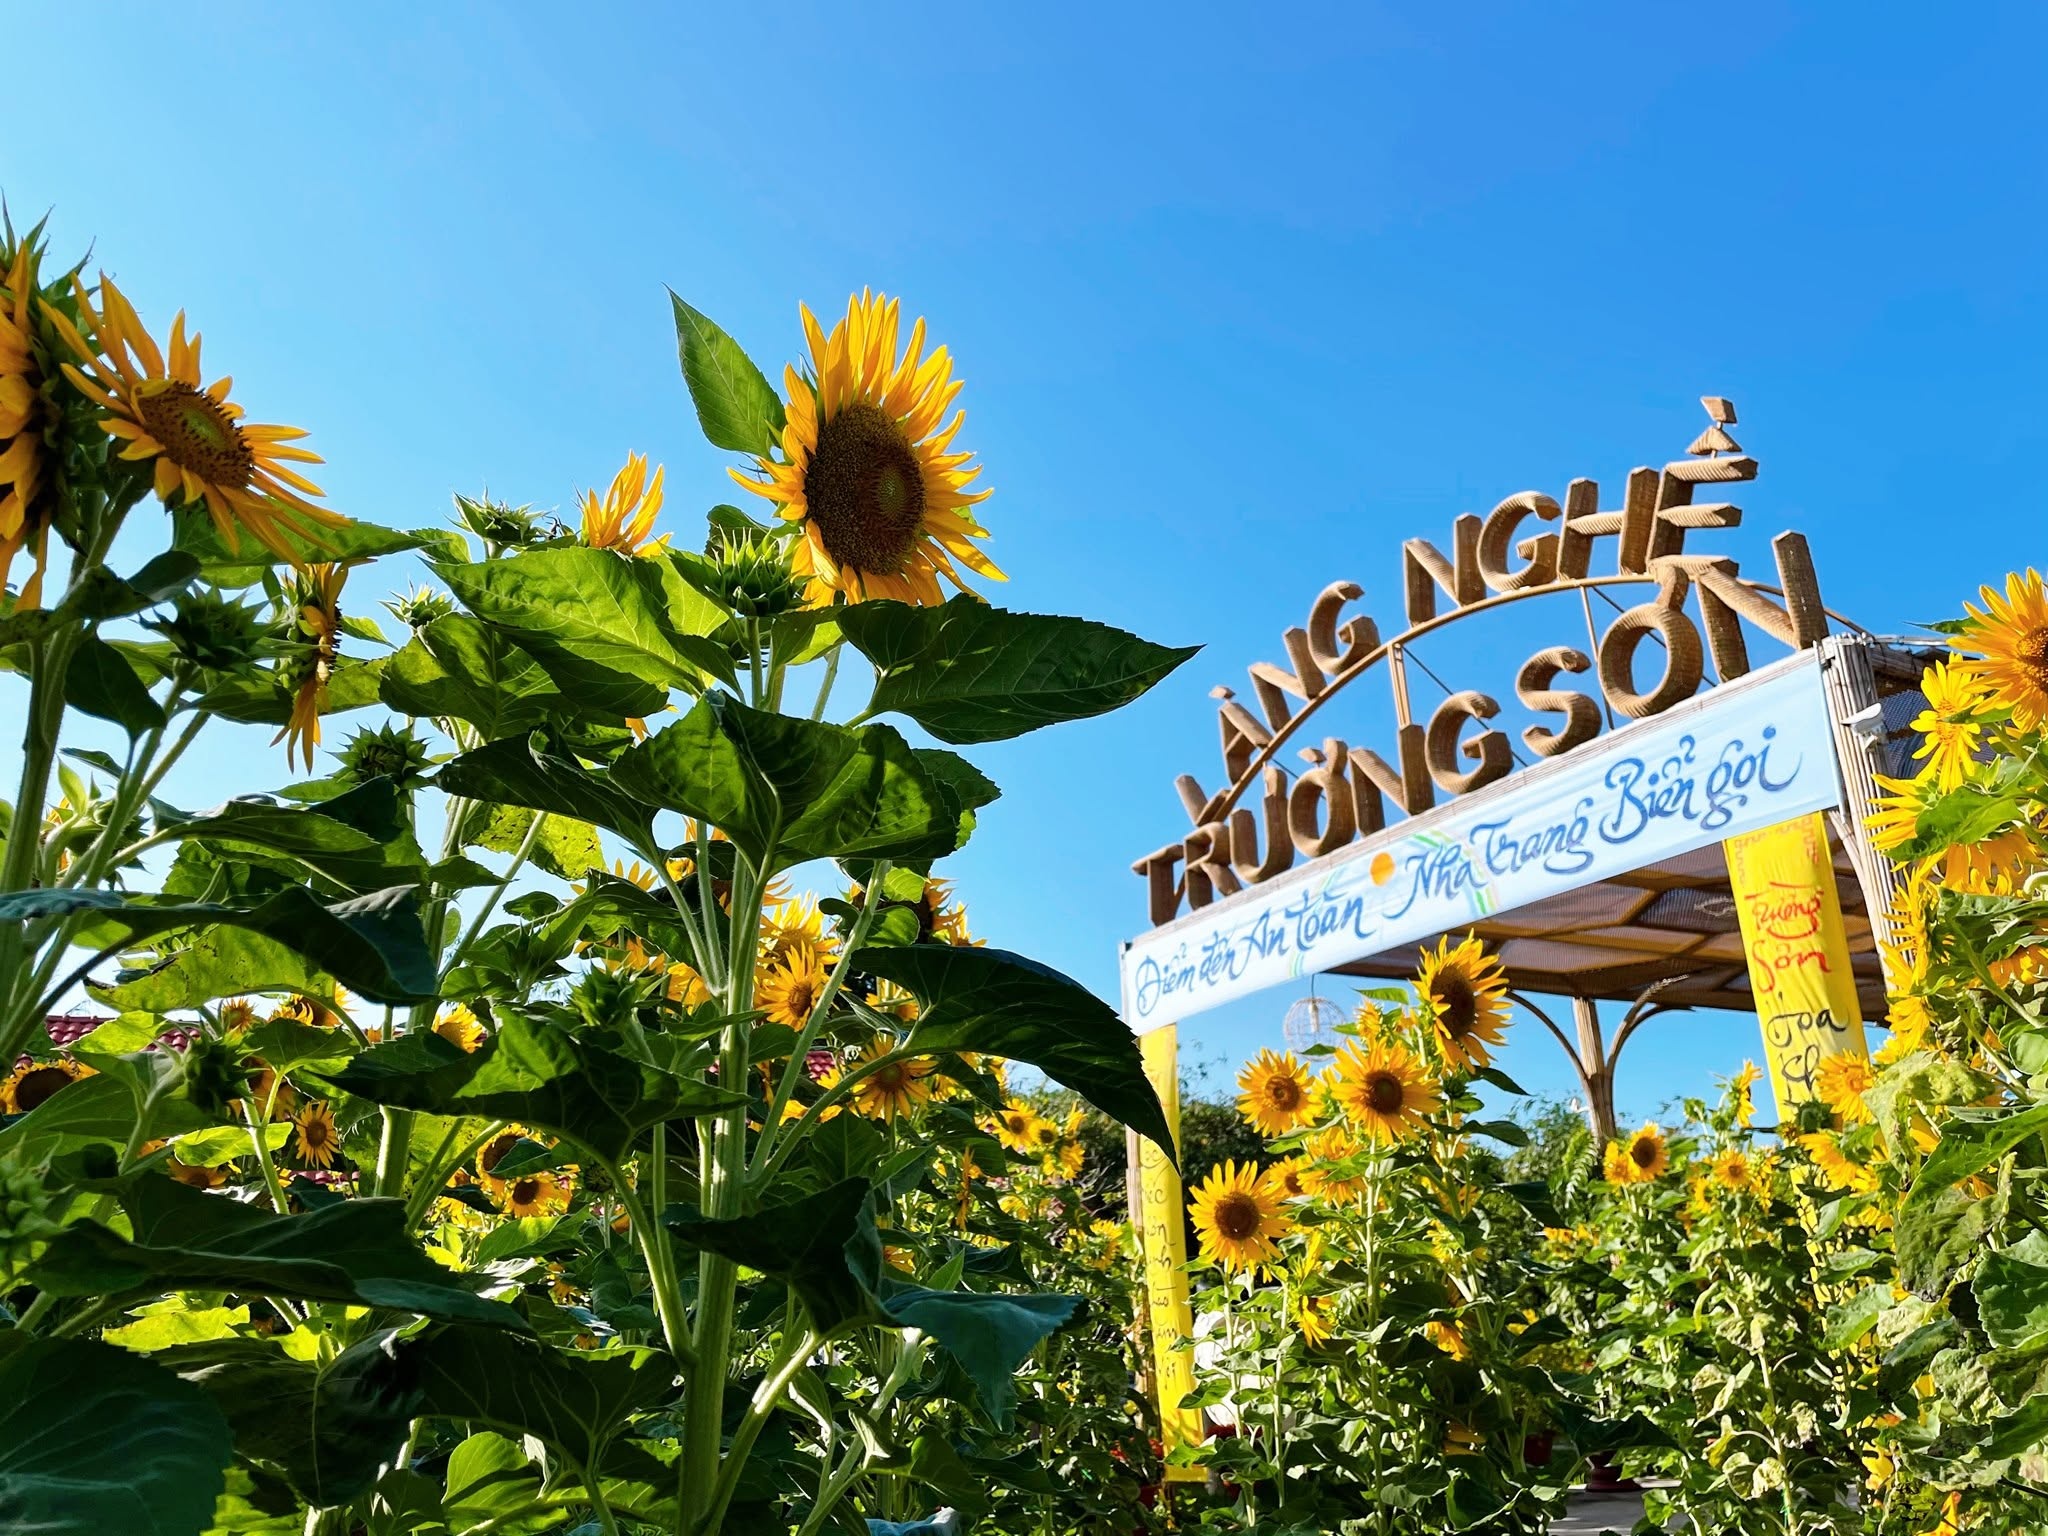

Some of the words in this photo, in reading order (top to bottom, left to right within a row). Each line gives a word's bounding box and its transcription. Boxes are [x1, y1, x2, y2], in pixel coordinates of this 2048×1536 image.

[1131, 690, 1515, 928] TRƯỜNG
[1516, 529, 1829, 757] SƠN
[1175, 580, 1381, 828] LÀNG
[1236, 907, 1291, 977] An
[1382, 843, 1488, 919] Nha
[1470, 798, 1594, 878] Trang
[1600, 734, 1699, 844] Biển
[1700, 725, 1802, 831] gọi
